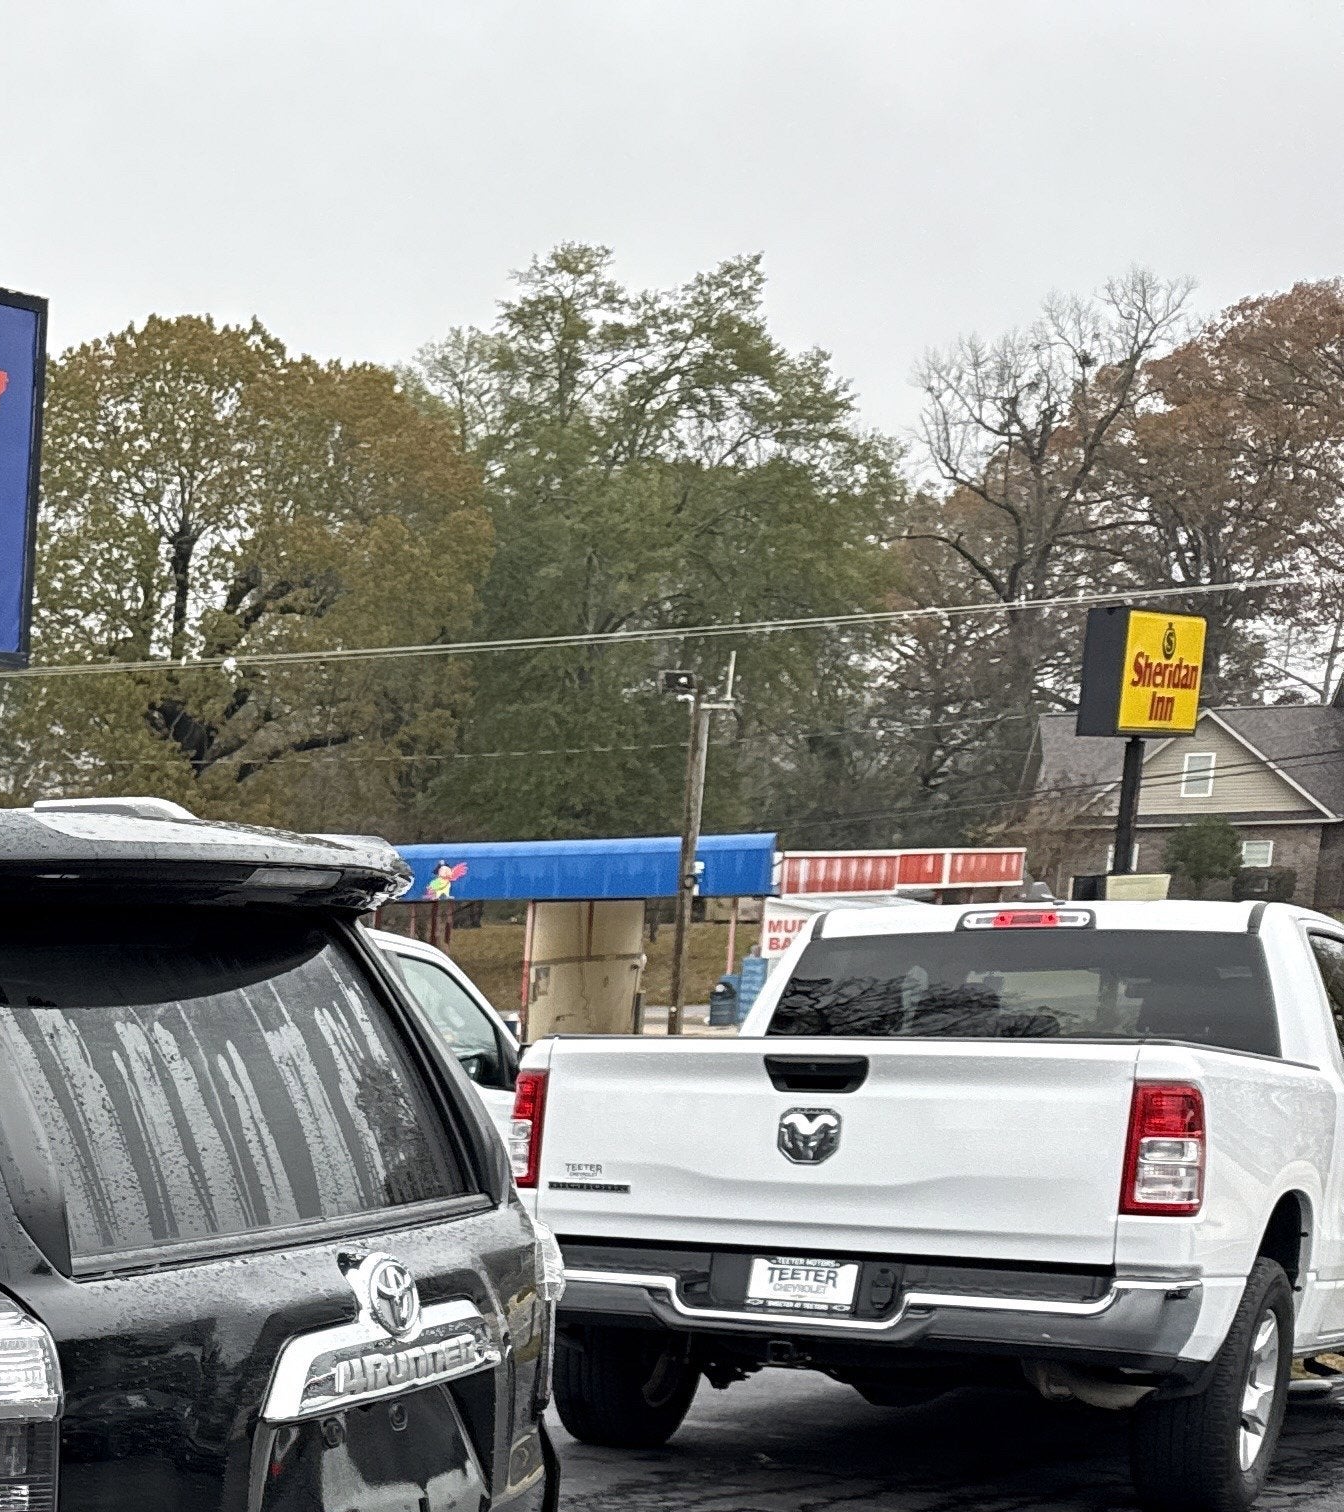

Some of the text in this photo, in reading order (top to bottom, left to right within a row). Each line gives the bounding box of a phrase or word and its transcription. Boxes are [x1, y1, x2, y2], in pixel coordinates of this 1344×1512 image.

[1130, 651, 1199, 690] Sheridan
[1148, 691, 1175, 721] Inn
[565, 1163, 603, 1175] TEETER
[767, 1267, 839, 1289] TEETER
[773, 1282, 827, 1295] CHEVROLET
